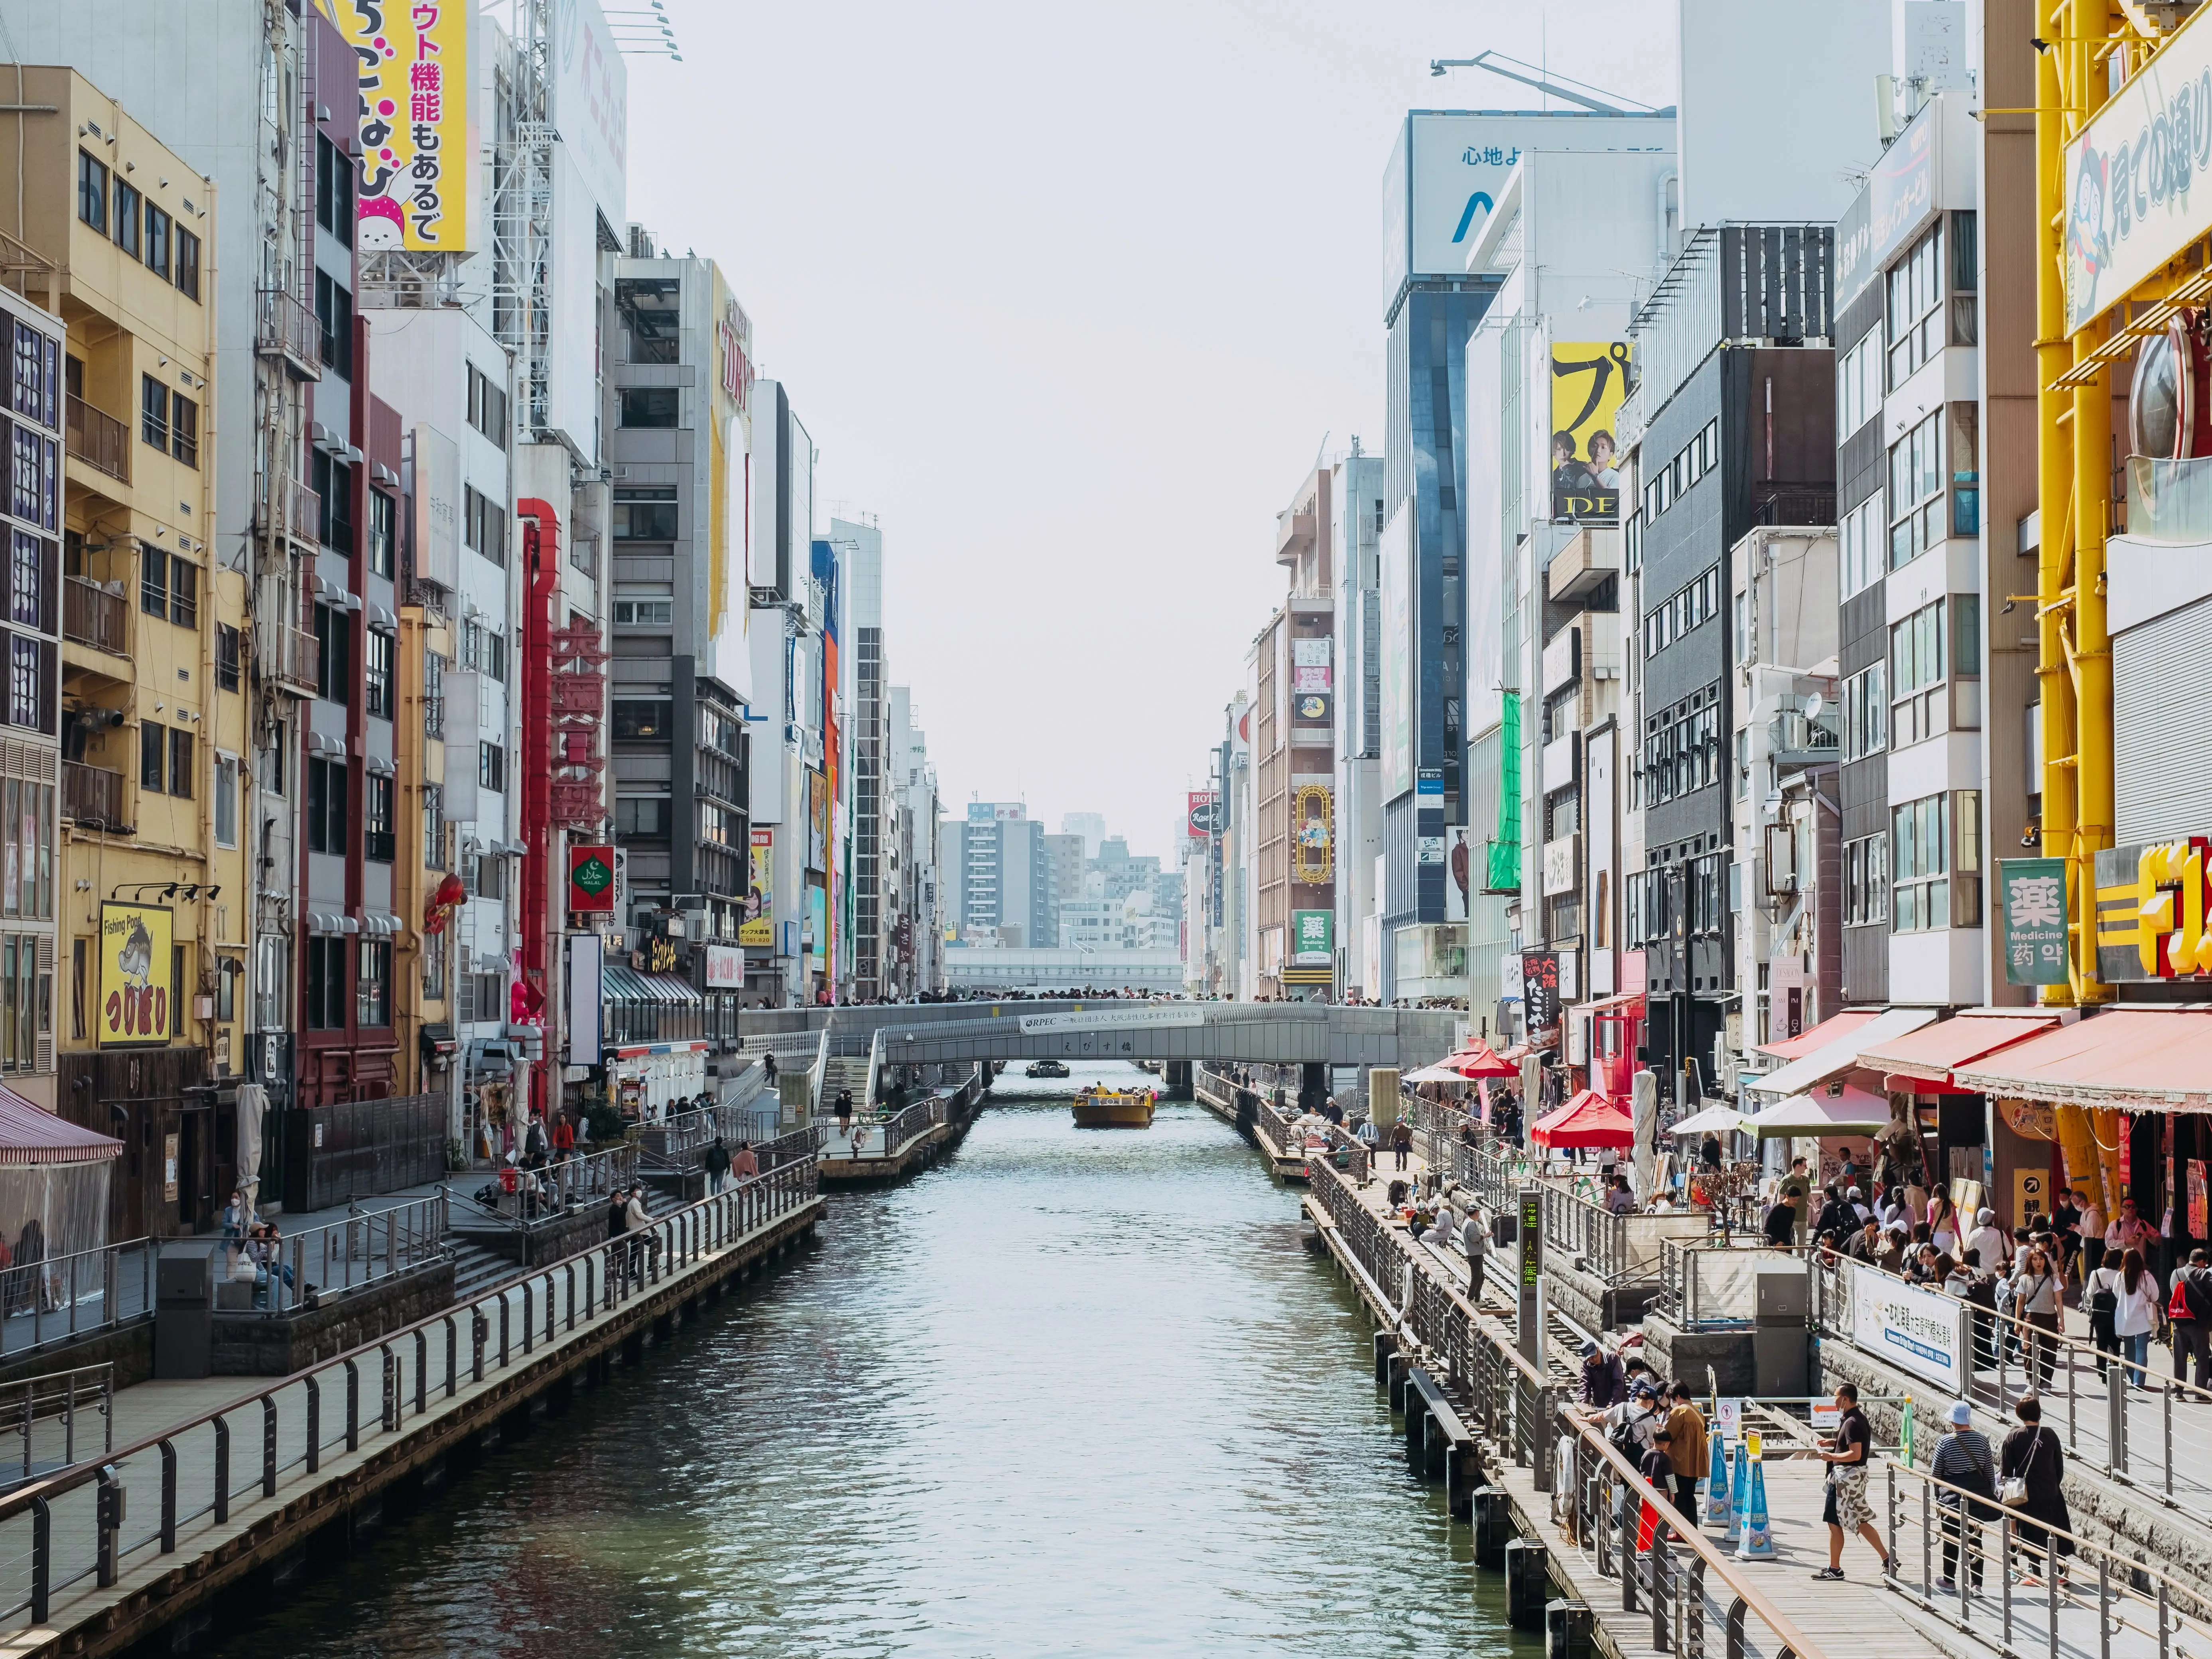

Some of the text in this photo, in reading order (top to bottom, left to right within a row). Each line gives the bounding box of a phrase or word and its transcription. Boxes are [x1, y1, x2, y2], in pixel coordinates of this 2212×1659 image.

[2111, 65, 2212, 250] 見ての通り
[2009, 876, 2061, 927] 薬
[104, 912, 142, 936] Fishing Pond
[1302, 916, 1325, 939] 薬
[2010, 931, 2063, 941] Medicine
[2012, 943, 2034, 966] 药
[2041, 943, 2063, 965] 약
[1542, 958, 1557, 988] 大阪
[1063, 1015, 1107, 1024] 一般社団法人
[1527, 977, 1545, 1044] たこやき
[1064, 1042, 1131, 1052] えびす橋
